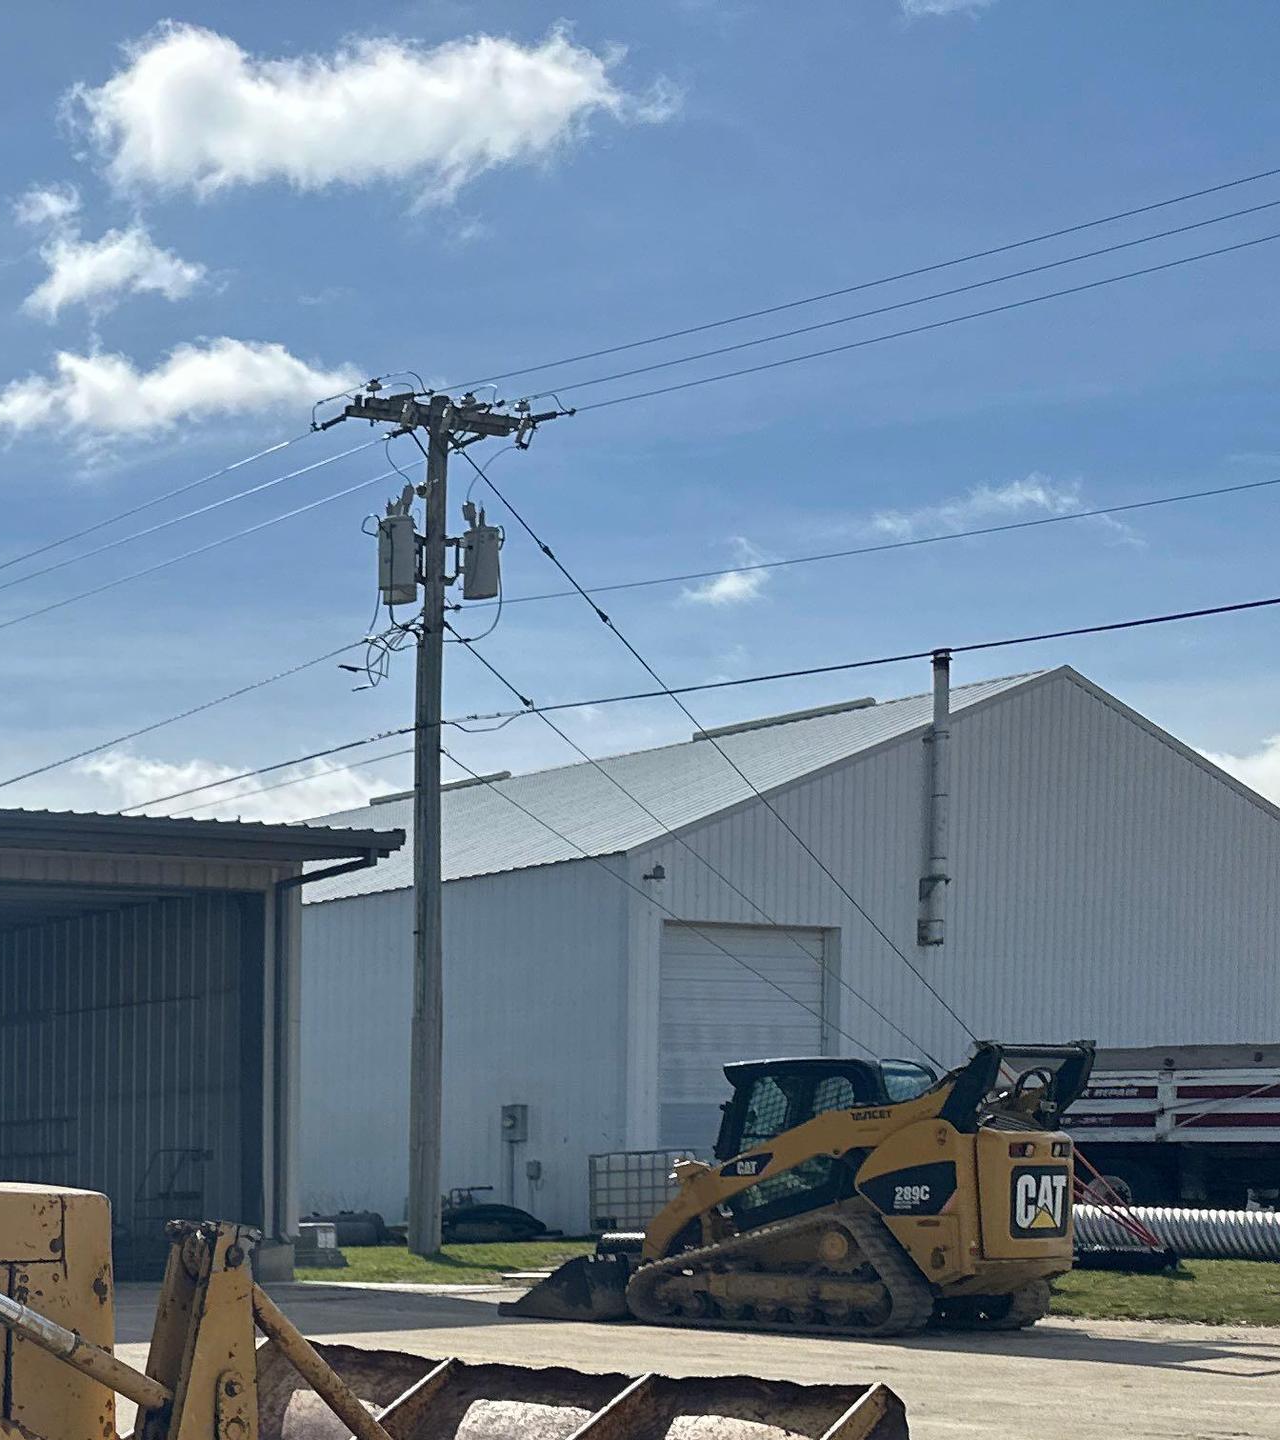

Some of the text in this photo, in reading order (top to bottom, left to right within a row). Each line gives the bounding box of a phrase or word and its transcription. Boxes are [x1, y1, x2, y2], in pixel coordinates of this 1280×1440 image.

[736, 1160, 758, 1176] CAT
[894, 1185, 931, 1201] 289C
[1014, 1174, 1068, 1229] CAT
